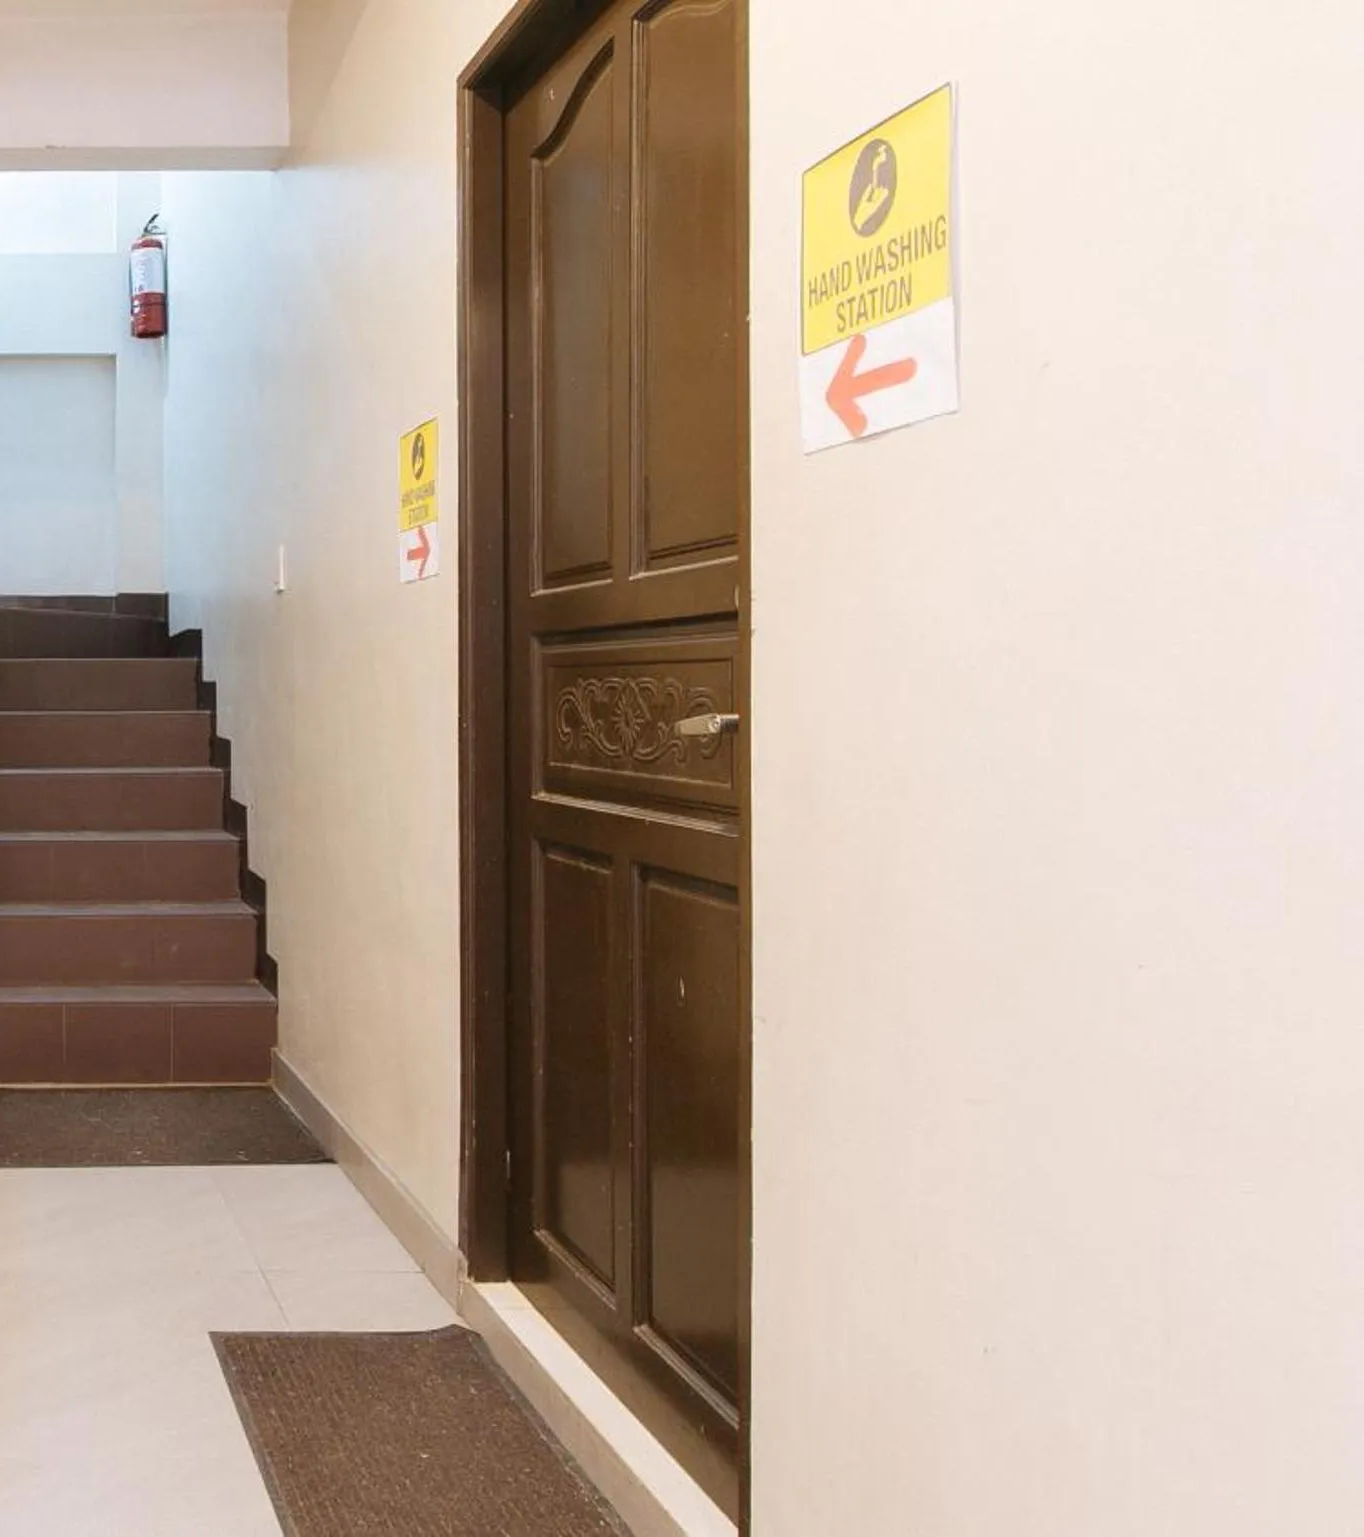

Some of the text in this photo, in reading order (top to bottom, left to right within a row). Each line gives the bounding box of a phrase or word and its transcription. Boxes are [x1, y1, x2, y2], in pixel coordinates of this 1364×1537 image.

[808, 214, 947, 309] HAND WASHING
[836, 272, 912, 333] STATION
